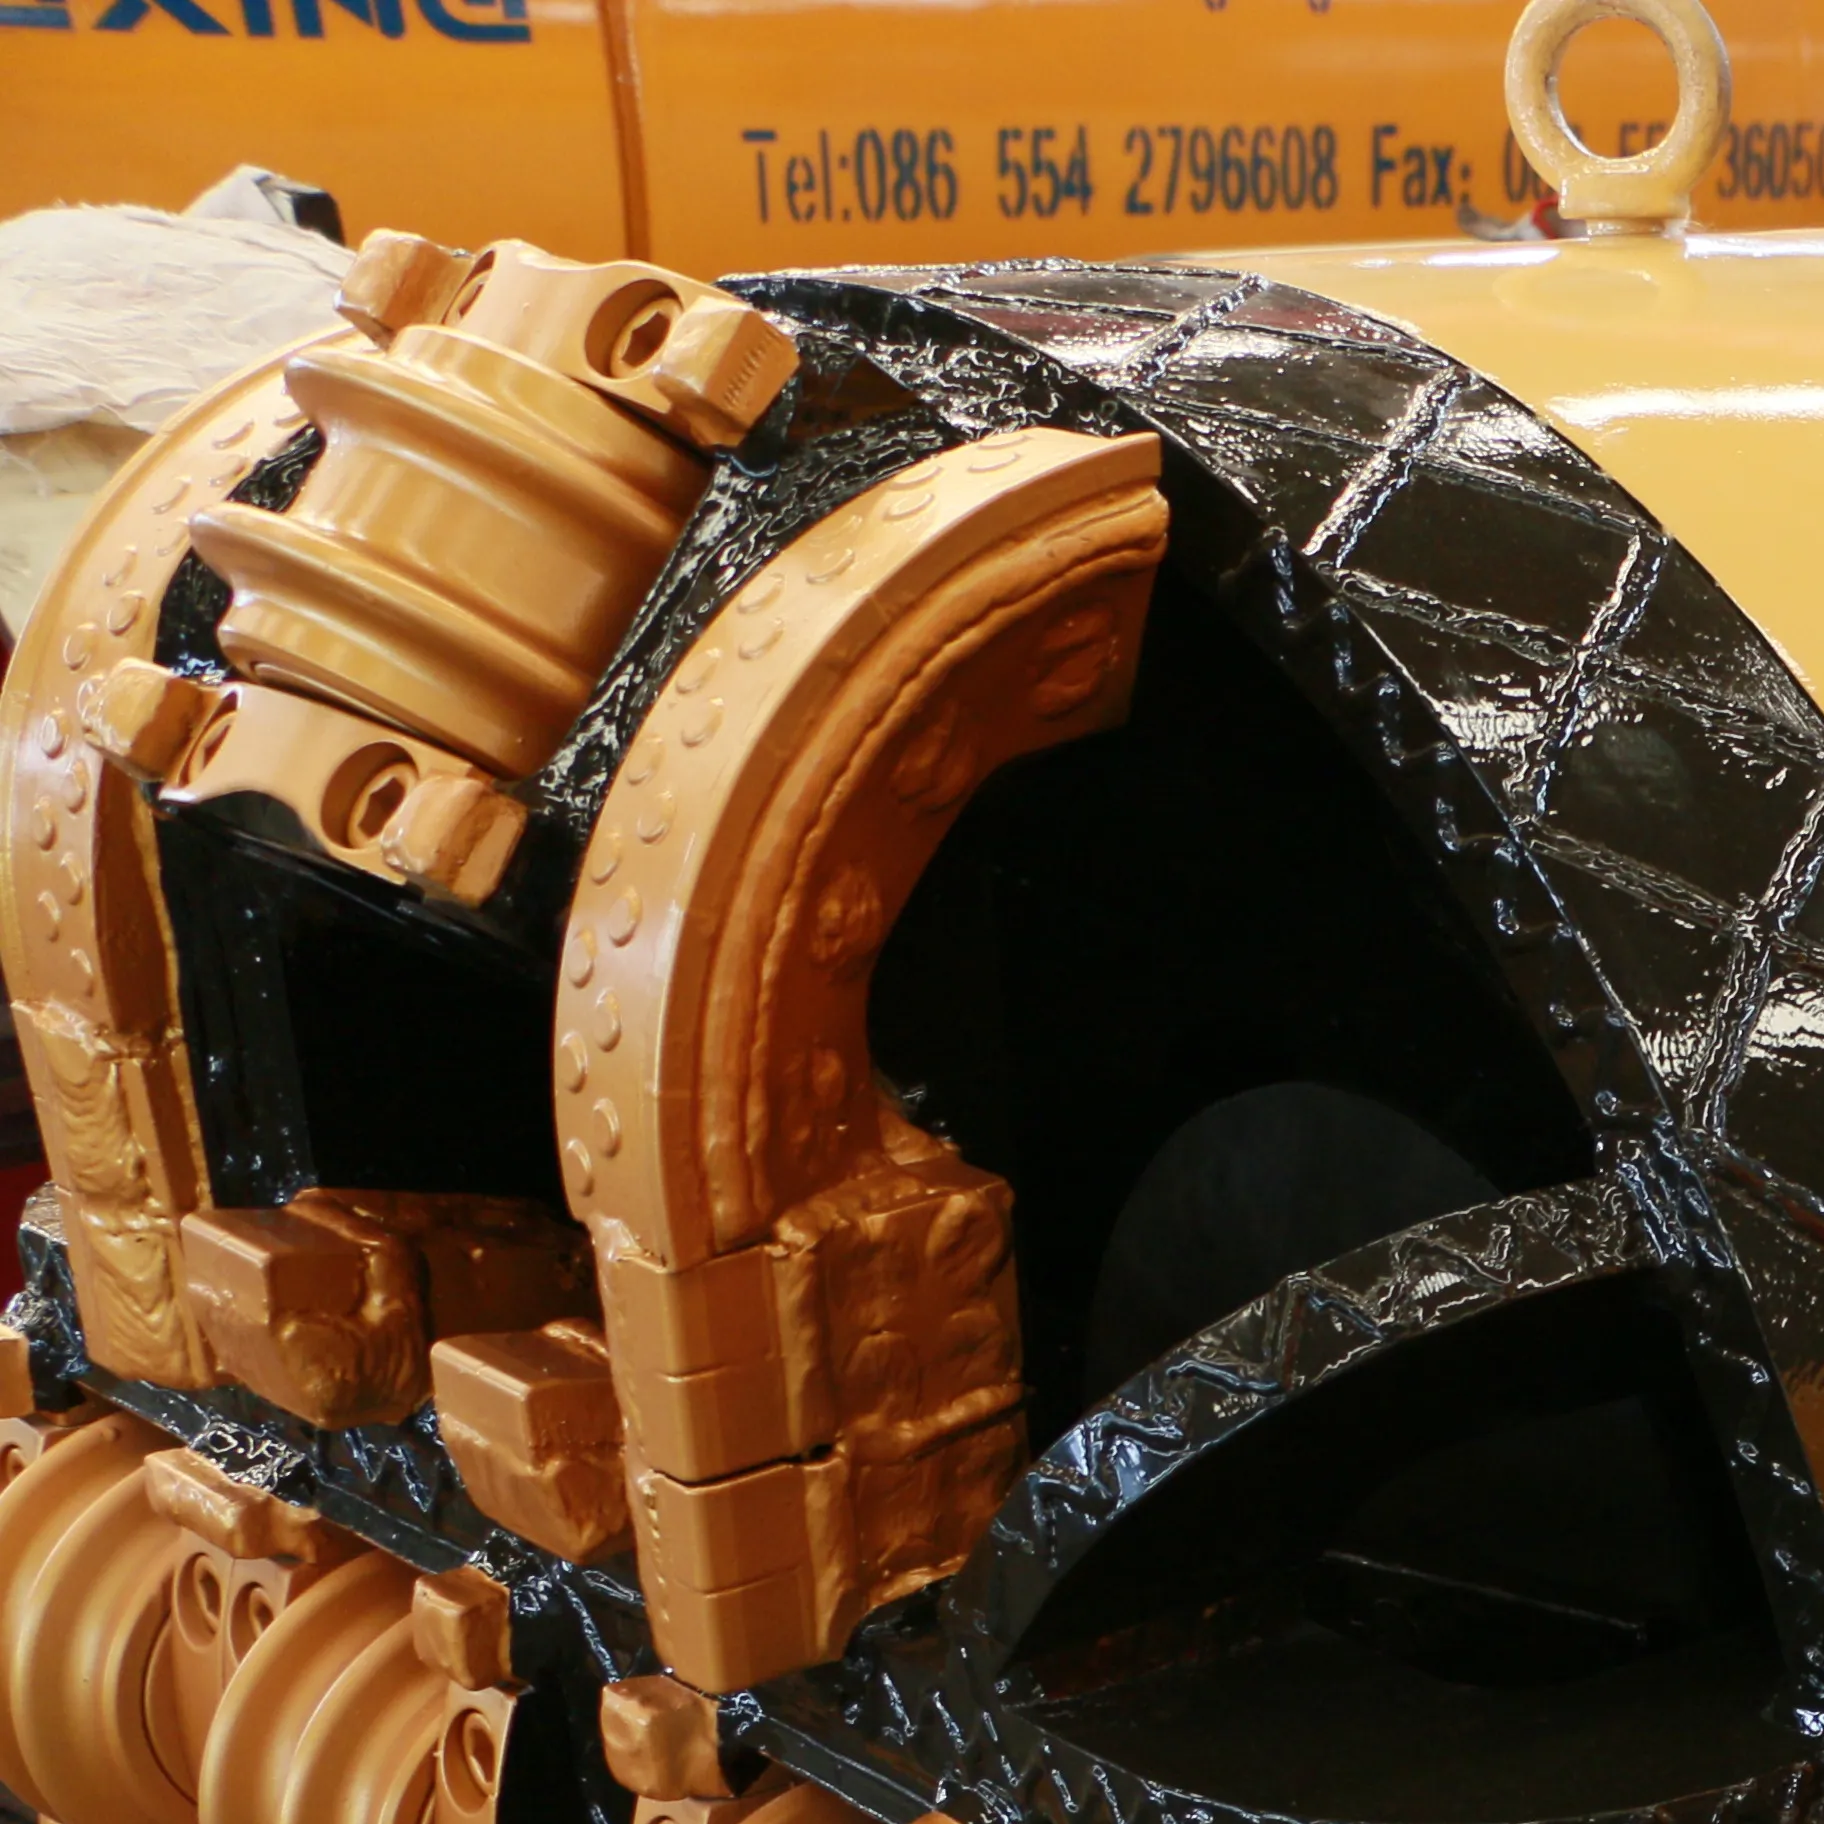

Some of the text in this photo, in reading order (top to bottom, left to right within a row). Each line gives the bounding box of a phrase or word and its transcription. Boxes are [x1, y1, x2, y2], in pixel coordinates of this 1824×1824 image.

[997, 124, 1094, 219] 554
[1123, 124, 1338, 216] 2796608
[1371, 123, 1475, 210] Fax:
